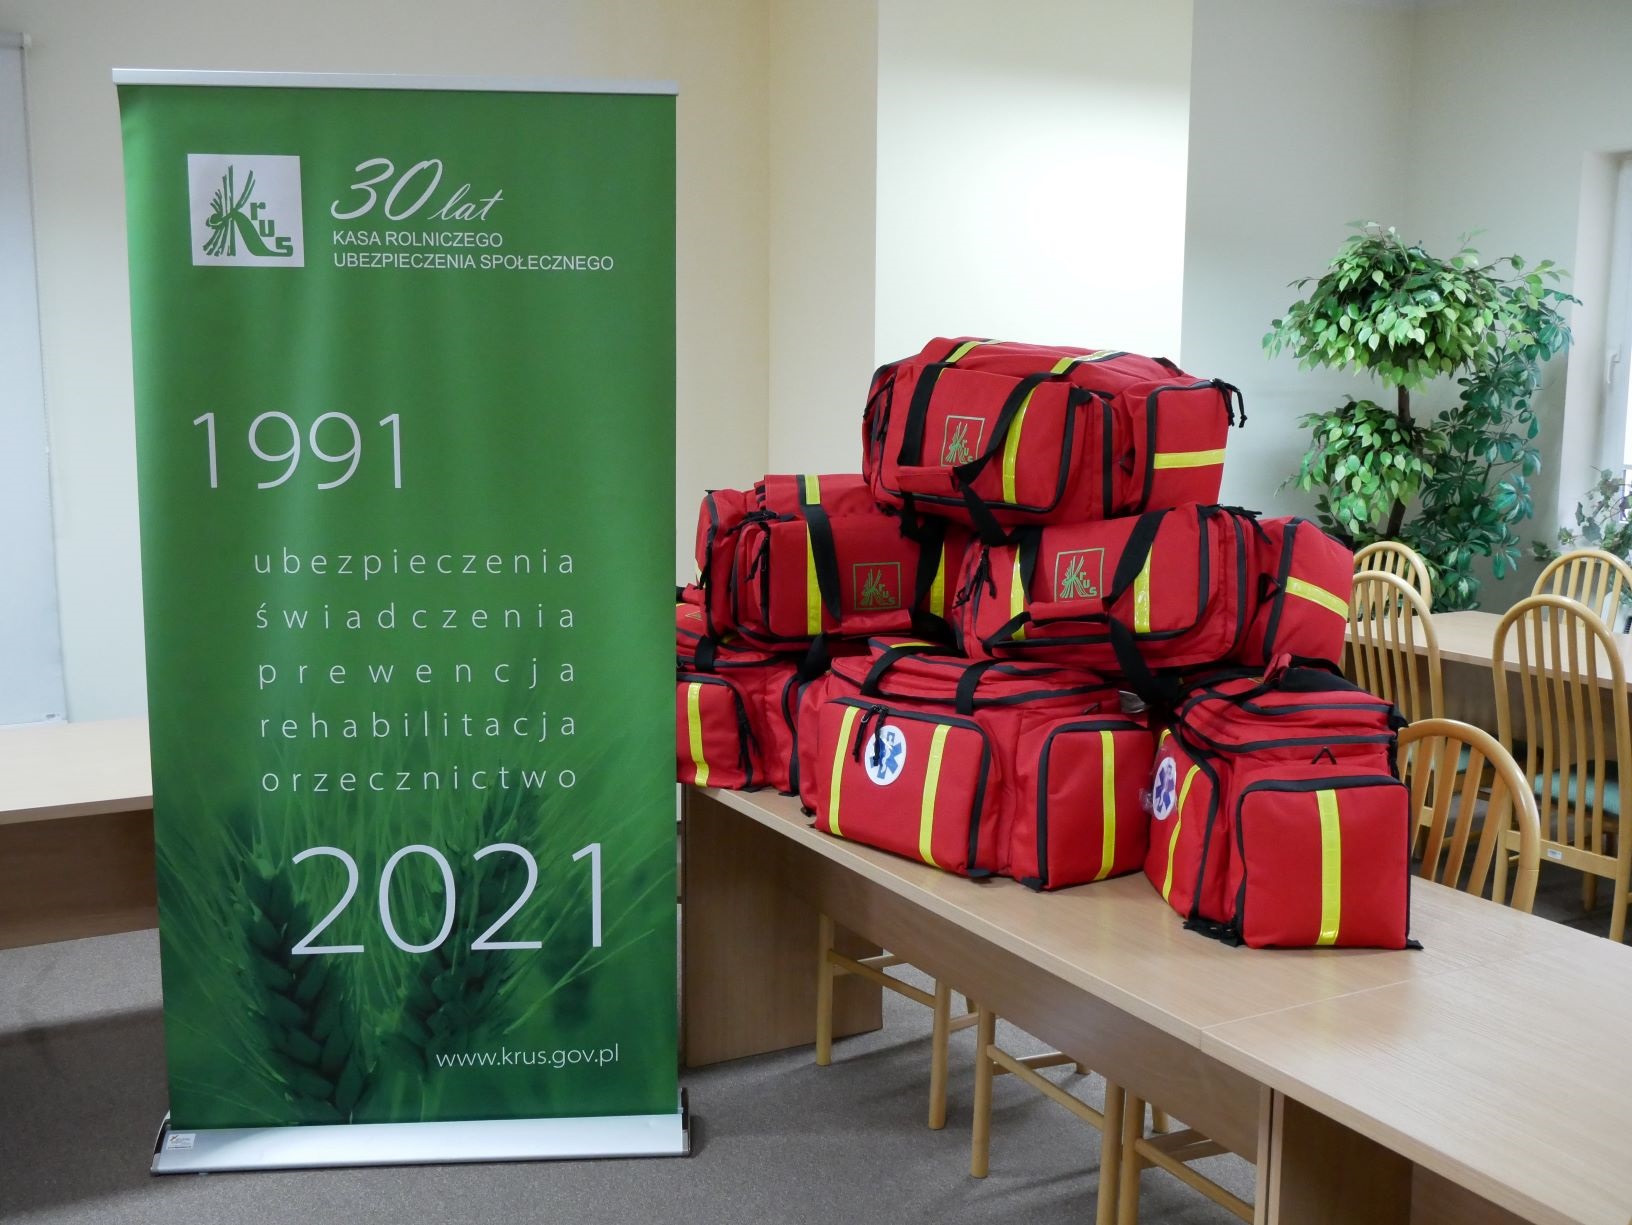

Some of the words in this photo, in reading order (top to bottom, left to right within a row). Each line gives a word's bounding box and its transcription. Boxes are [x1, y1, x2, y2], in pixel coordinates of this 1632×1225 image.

[330, 157, 443, 221] 30
[427, 183, 504, 221] lat
[332, 230, 382, 246] KASA
[385, 231, 503, 248] ROLNICZEGO
[333, 252, 476, 269] UBEZPIECZENIA
[479, 254, 615, 271] SPOŁECZNEGO
[192, 410, 403, 491] 1991
[254, 546, 574, 581] ubezpieczenia
[256, 602, 575, 630] świadczenia
[258, 657, 575, 690] prewencja
[260, 710, 576, 743] rehabilitacja
[261, 765, 577, 792] orzecznictwo
[290, 842, 603, 956] 2021
[435, 1043, 620, 1069] www.krus.gov.pl
